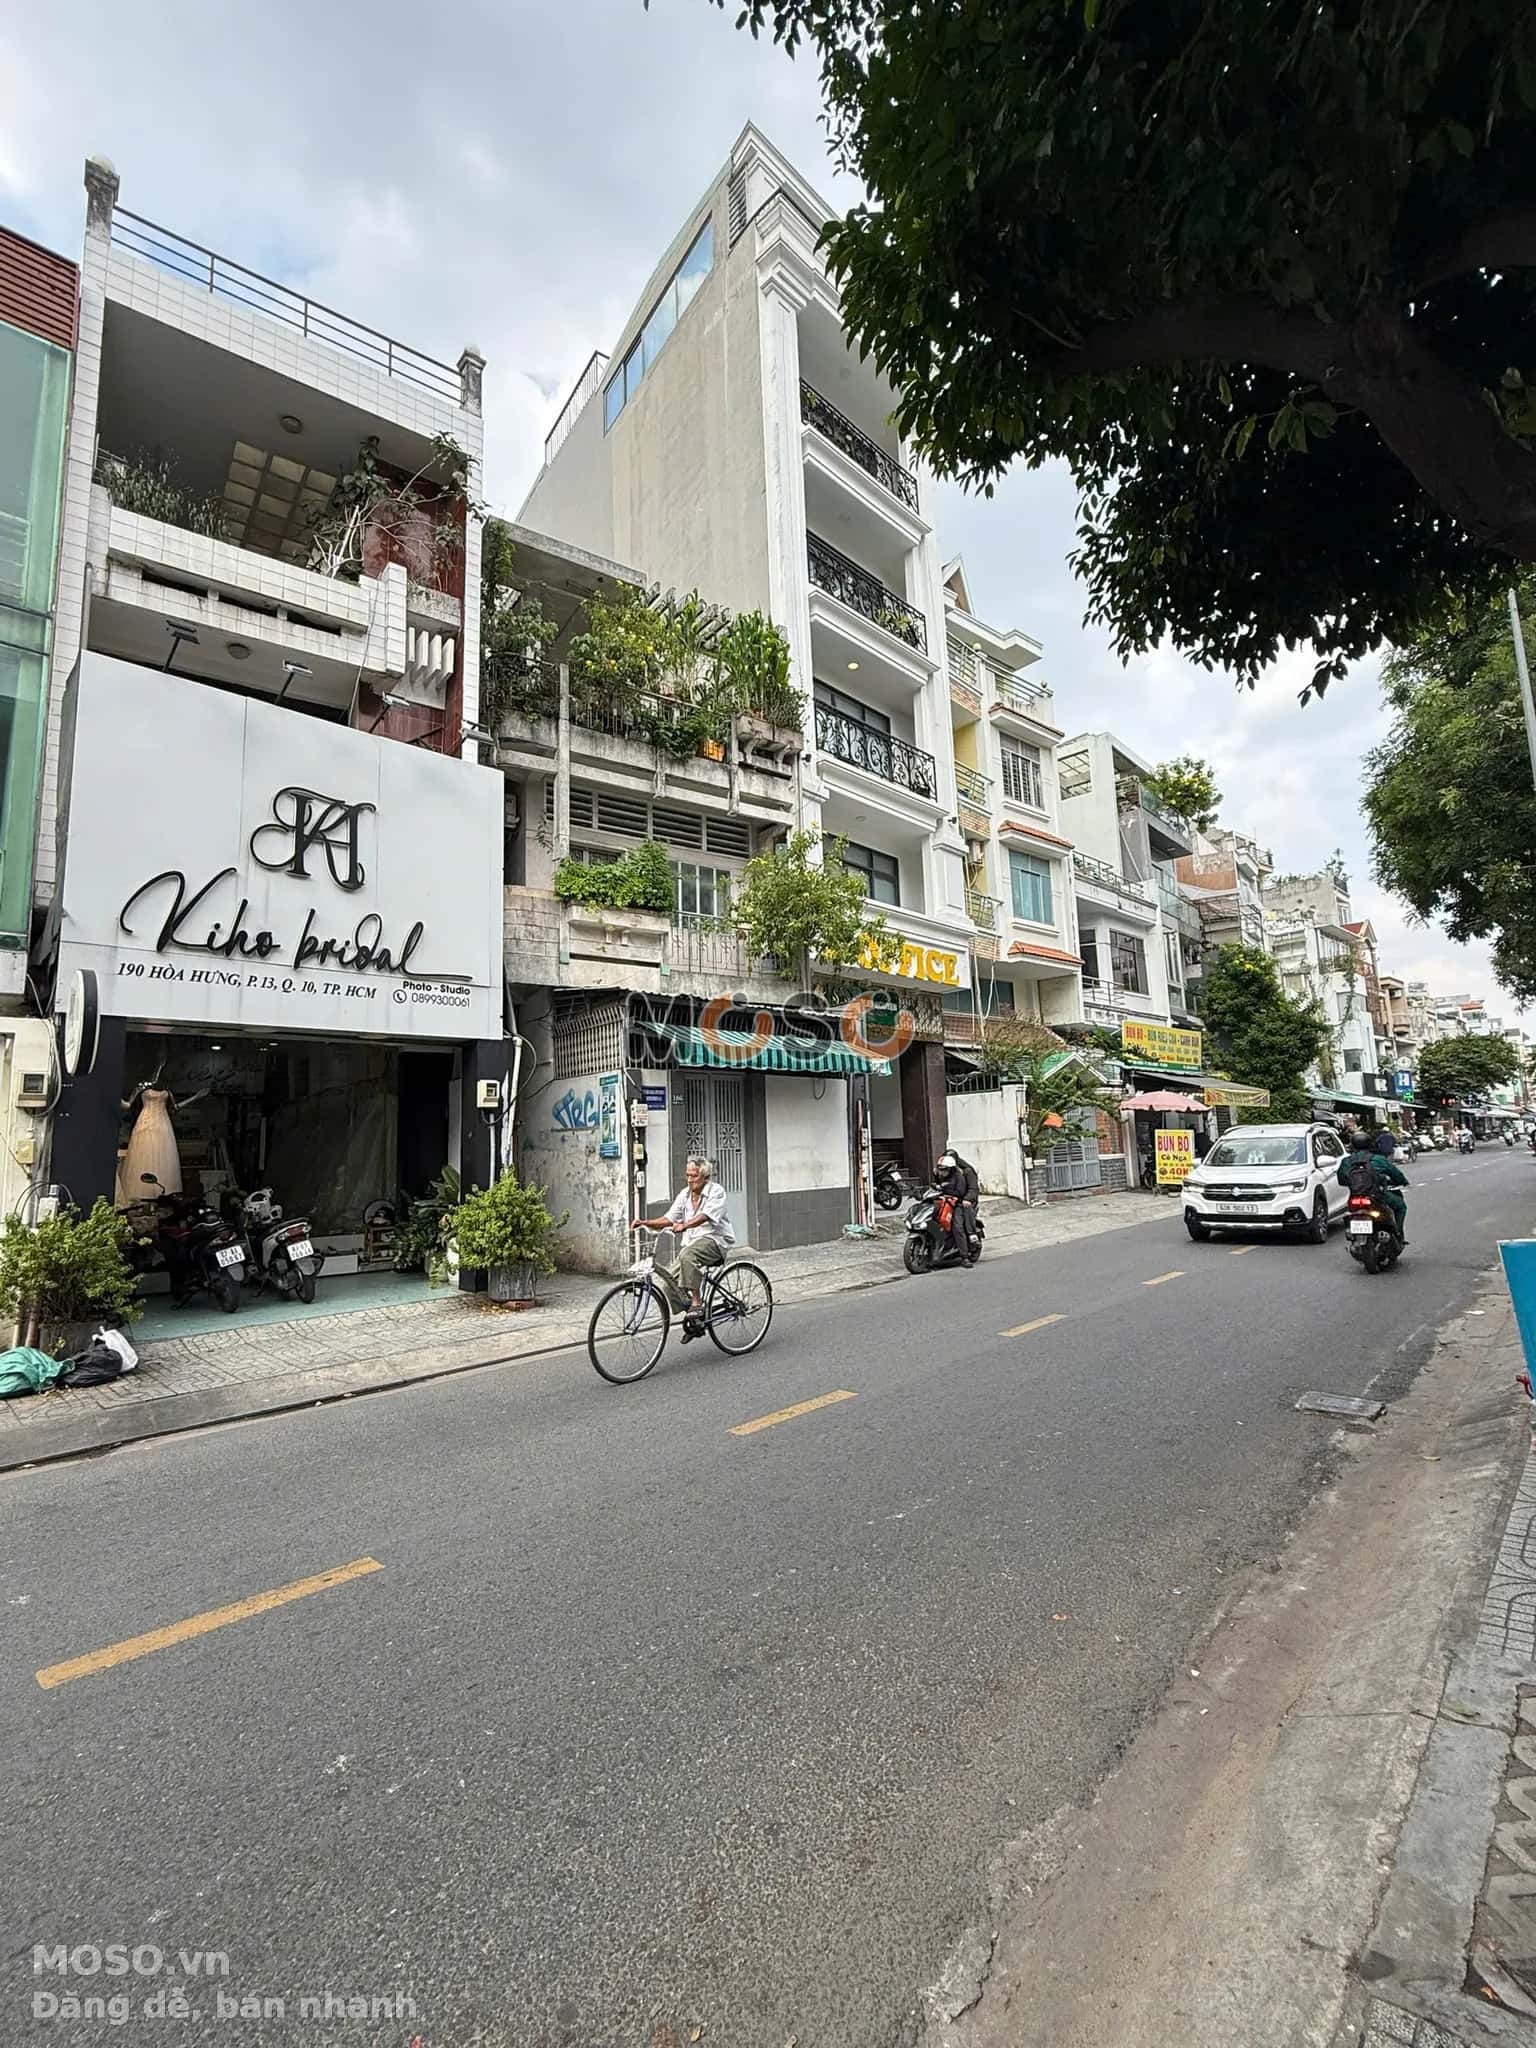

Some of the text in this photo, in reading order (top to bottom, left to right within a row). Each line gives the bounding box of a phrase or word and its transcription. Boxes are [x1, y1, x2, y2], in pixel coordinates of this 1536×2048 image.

[119, 867, 473, 981] Kiho bridal
[117, 963, 377, 999] 190 HÒA HƯNG, P. 13, Q. 10, TP. HCM
[402, 981, 432, 993] Photo
[440, 984, 471, 996] Studio
[412, 994, 470, 1009] 0899300061
